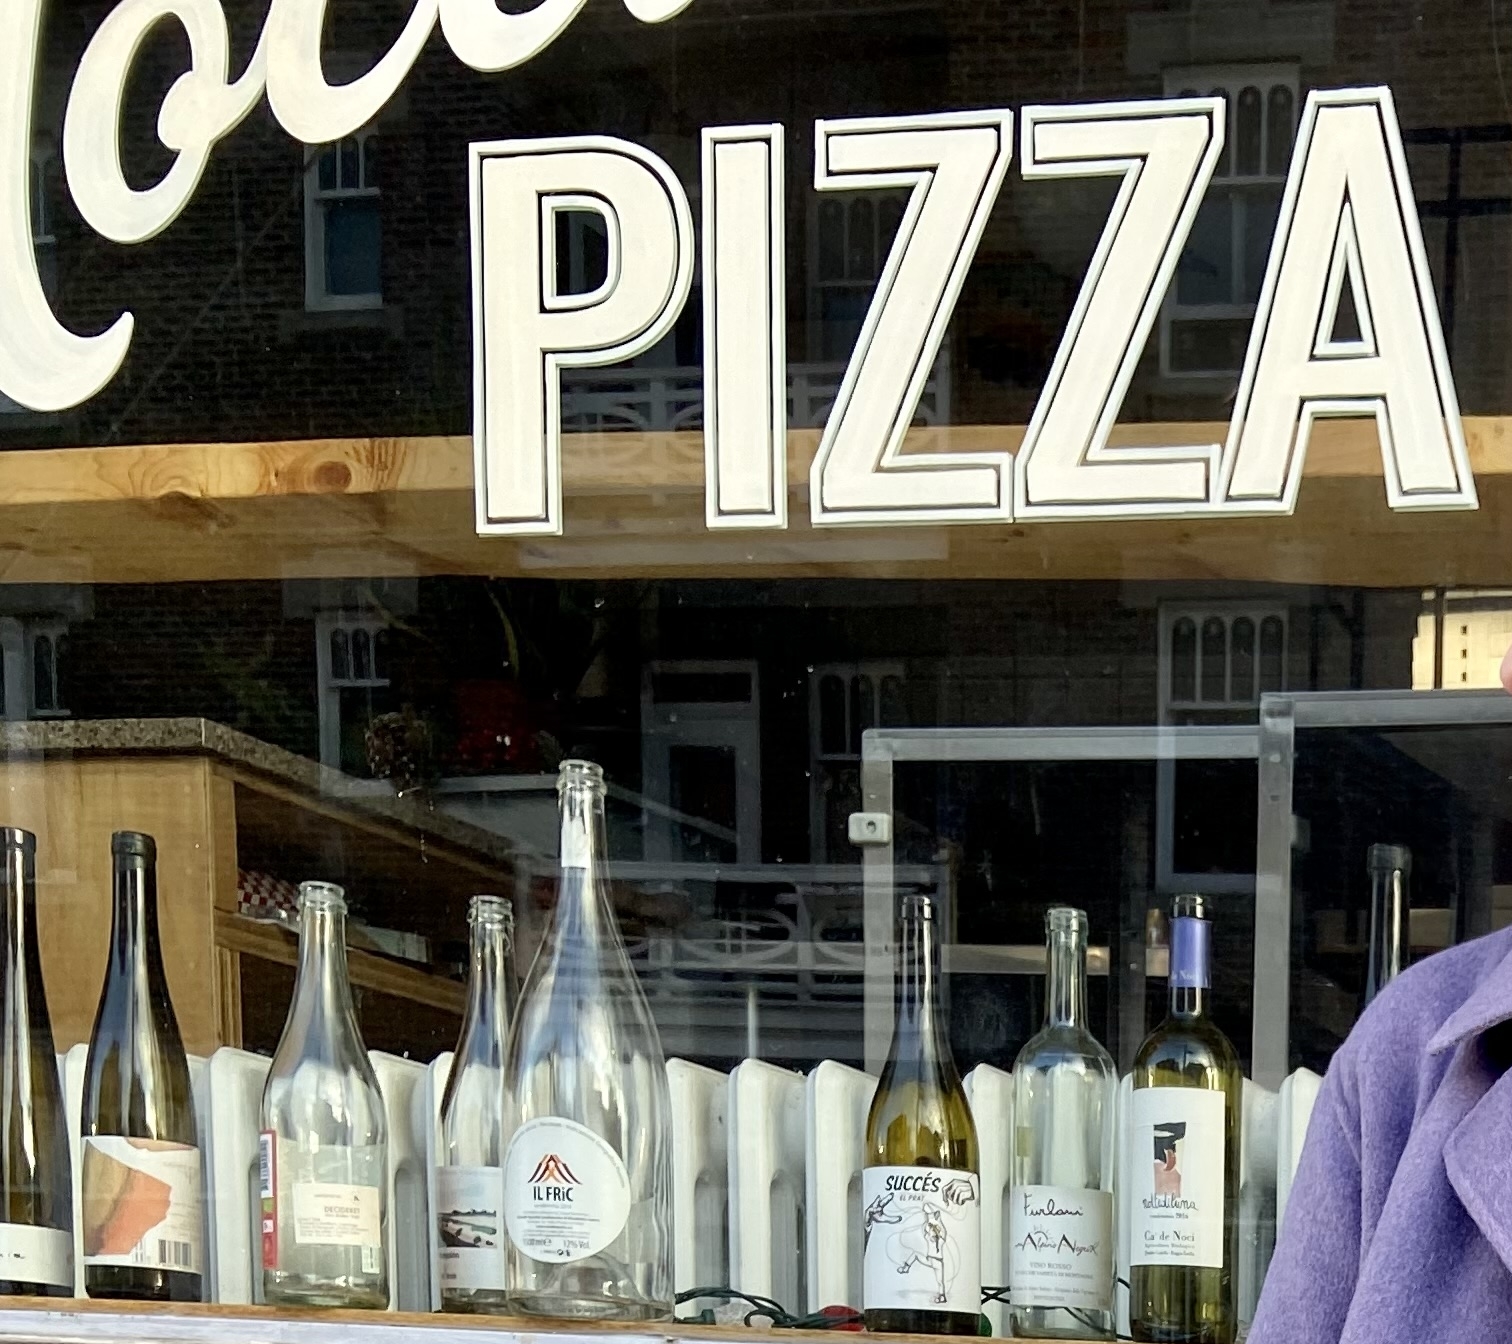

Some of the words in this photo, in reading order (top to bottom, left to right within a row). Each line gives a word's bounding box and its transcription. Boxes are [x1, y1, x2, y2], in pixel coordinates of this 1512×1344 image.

[469, 85, 1479, 537] PIZZA
[885, 1171, 942, 1192] SUCCÉS
[533, 1186, 544, 1201] IL
[1173, 1230, 1195, 1242] Noci
